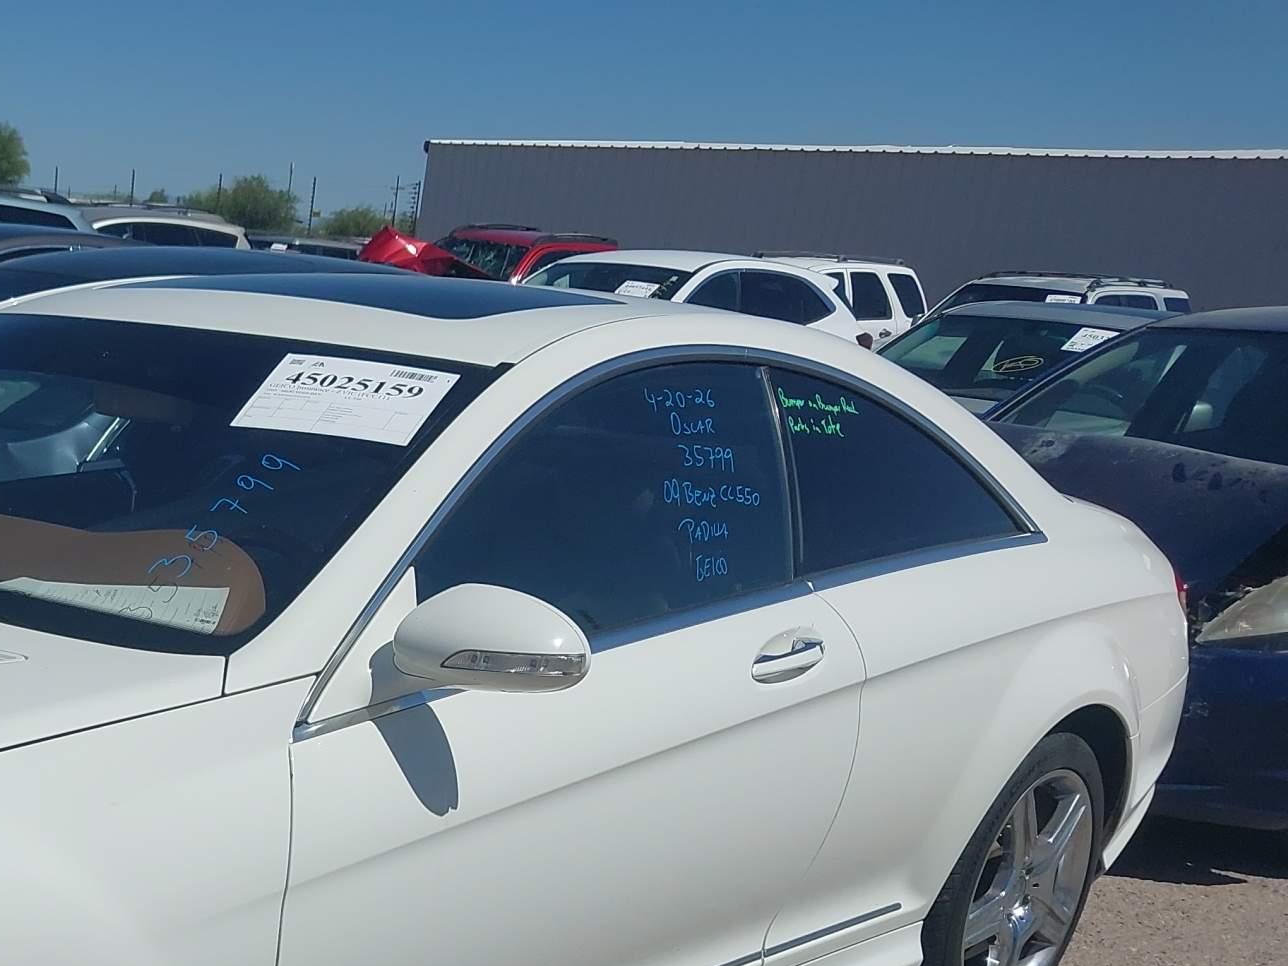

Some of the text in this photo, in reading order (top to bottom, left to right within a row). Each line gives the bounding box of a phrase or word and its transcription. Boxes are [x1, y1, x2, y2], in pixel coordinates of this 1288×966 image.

[285, 370, 424, 399] 45025159
[643, 387, 716, 412] 4-20-26
[677, 444, 735, 473] 35799
[148, 454, 301, 579] 35799
[695, 554, 728, 582] GEICO
